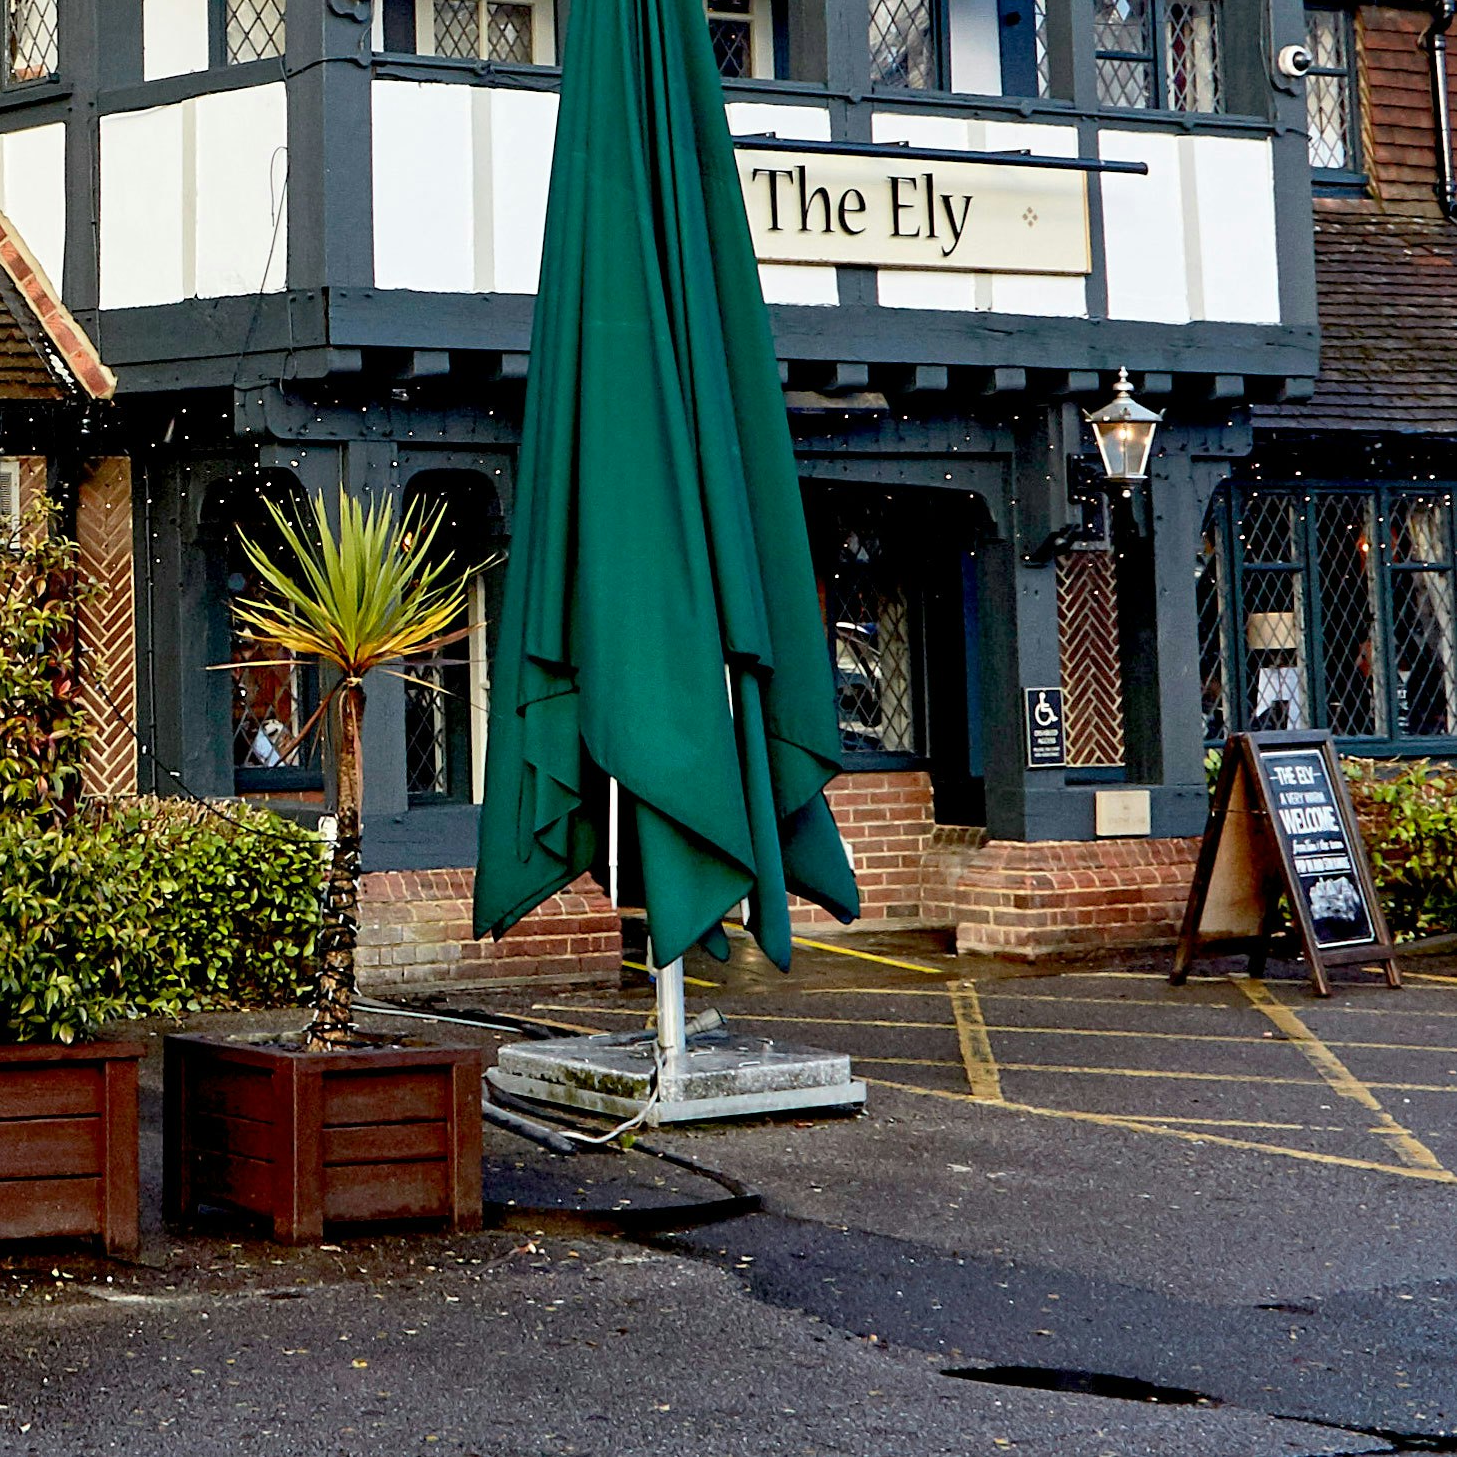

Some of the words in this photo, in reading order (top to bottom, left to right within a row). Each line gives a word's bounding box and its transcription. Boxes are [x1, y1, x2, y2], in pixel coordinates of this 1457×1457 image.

[752, 165, 866, 235] The
[887, 173, 973, 257] Ely
[1274, 766, 1297, 785] THE
[1295, 765, 1315, 784] ELY
[1278, 806, 1339, 834] WELCOME
